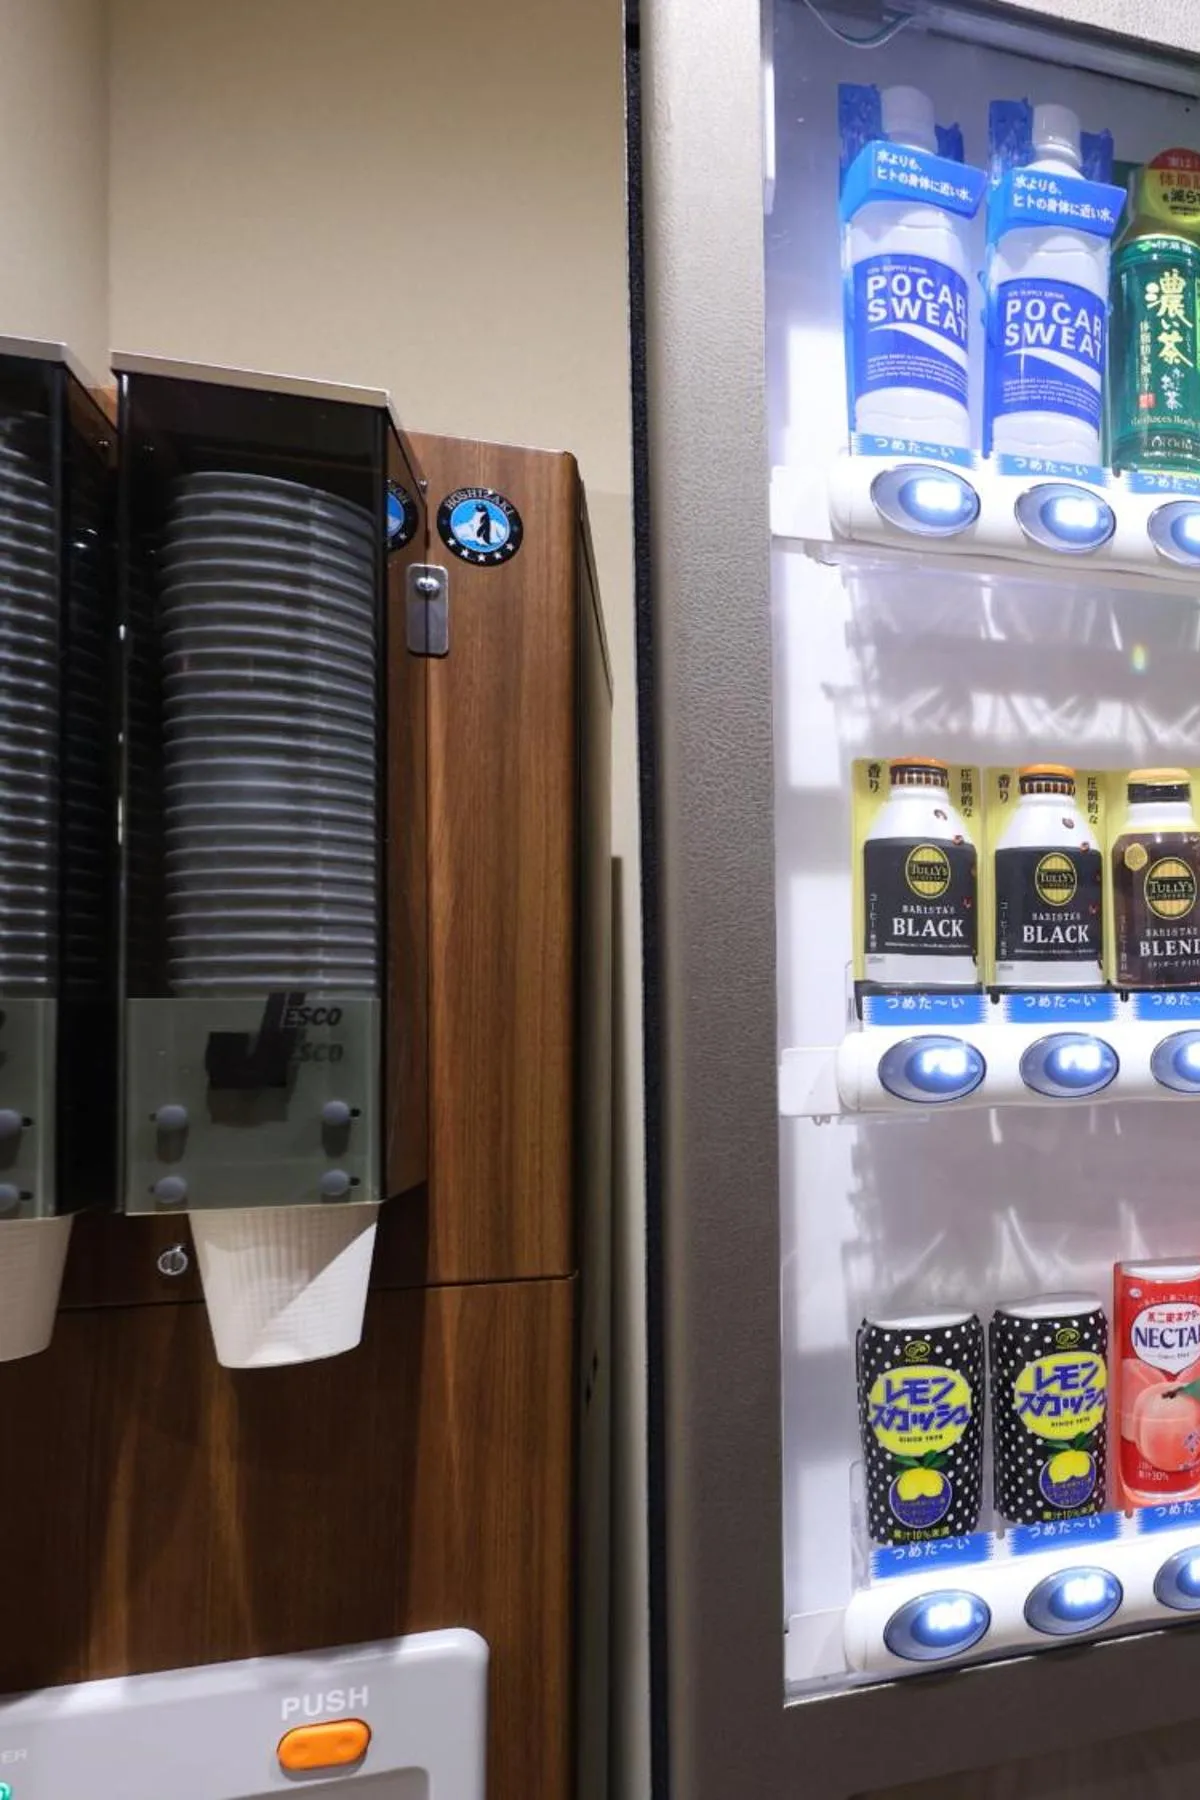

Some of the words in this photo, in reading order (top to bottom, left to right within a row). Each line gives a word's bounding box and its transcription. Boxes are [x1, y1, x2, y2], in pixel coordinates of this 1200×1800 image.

[868, 297, 968, 343] SWEAT
[1004, 322, 1101, 364] SWEAT
[444, 487, 514, 516] HOSHIZAKI
[892, 917, 965, 938] BLACK
[1022, 923, 1091, 944] BLACK
[886, 995, 966, 1011] つめた〜い
[1023, 995, 1097, 1009] つめた〜い
[1035, 1361, 1100, 1391] レモン
[885, 1376, 956, 1405] レモン
[1028, 1517, 1101, 1539] つめた〜い
[893, 1536, 970, 1560] つめた〜い
[281, 1685, 370, 1721] PUSH
